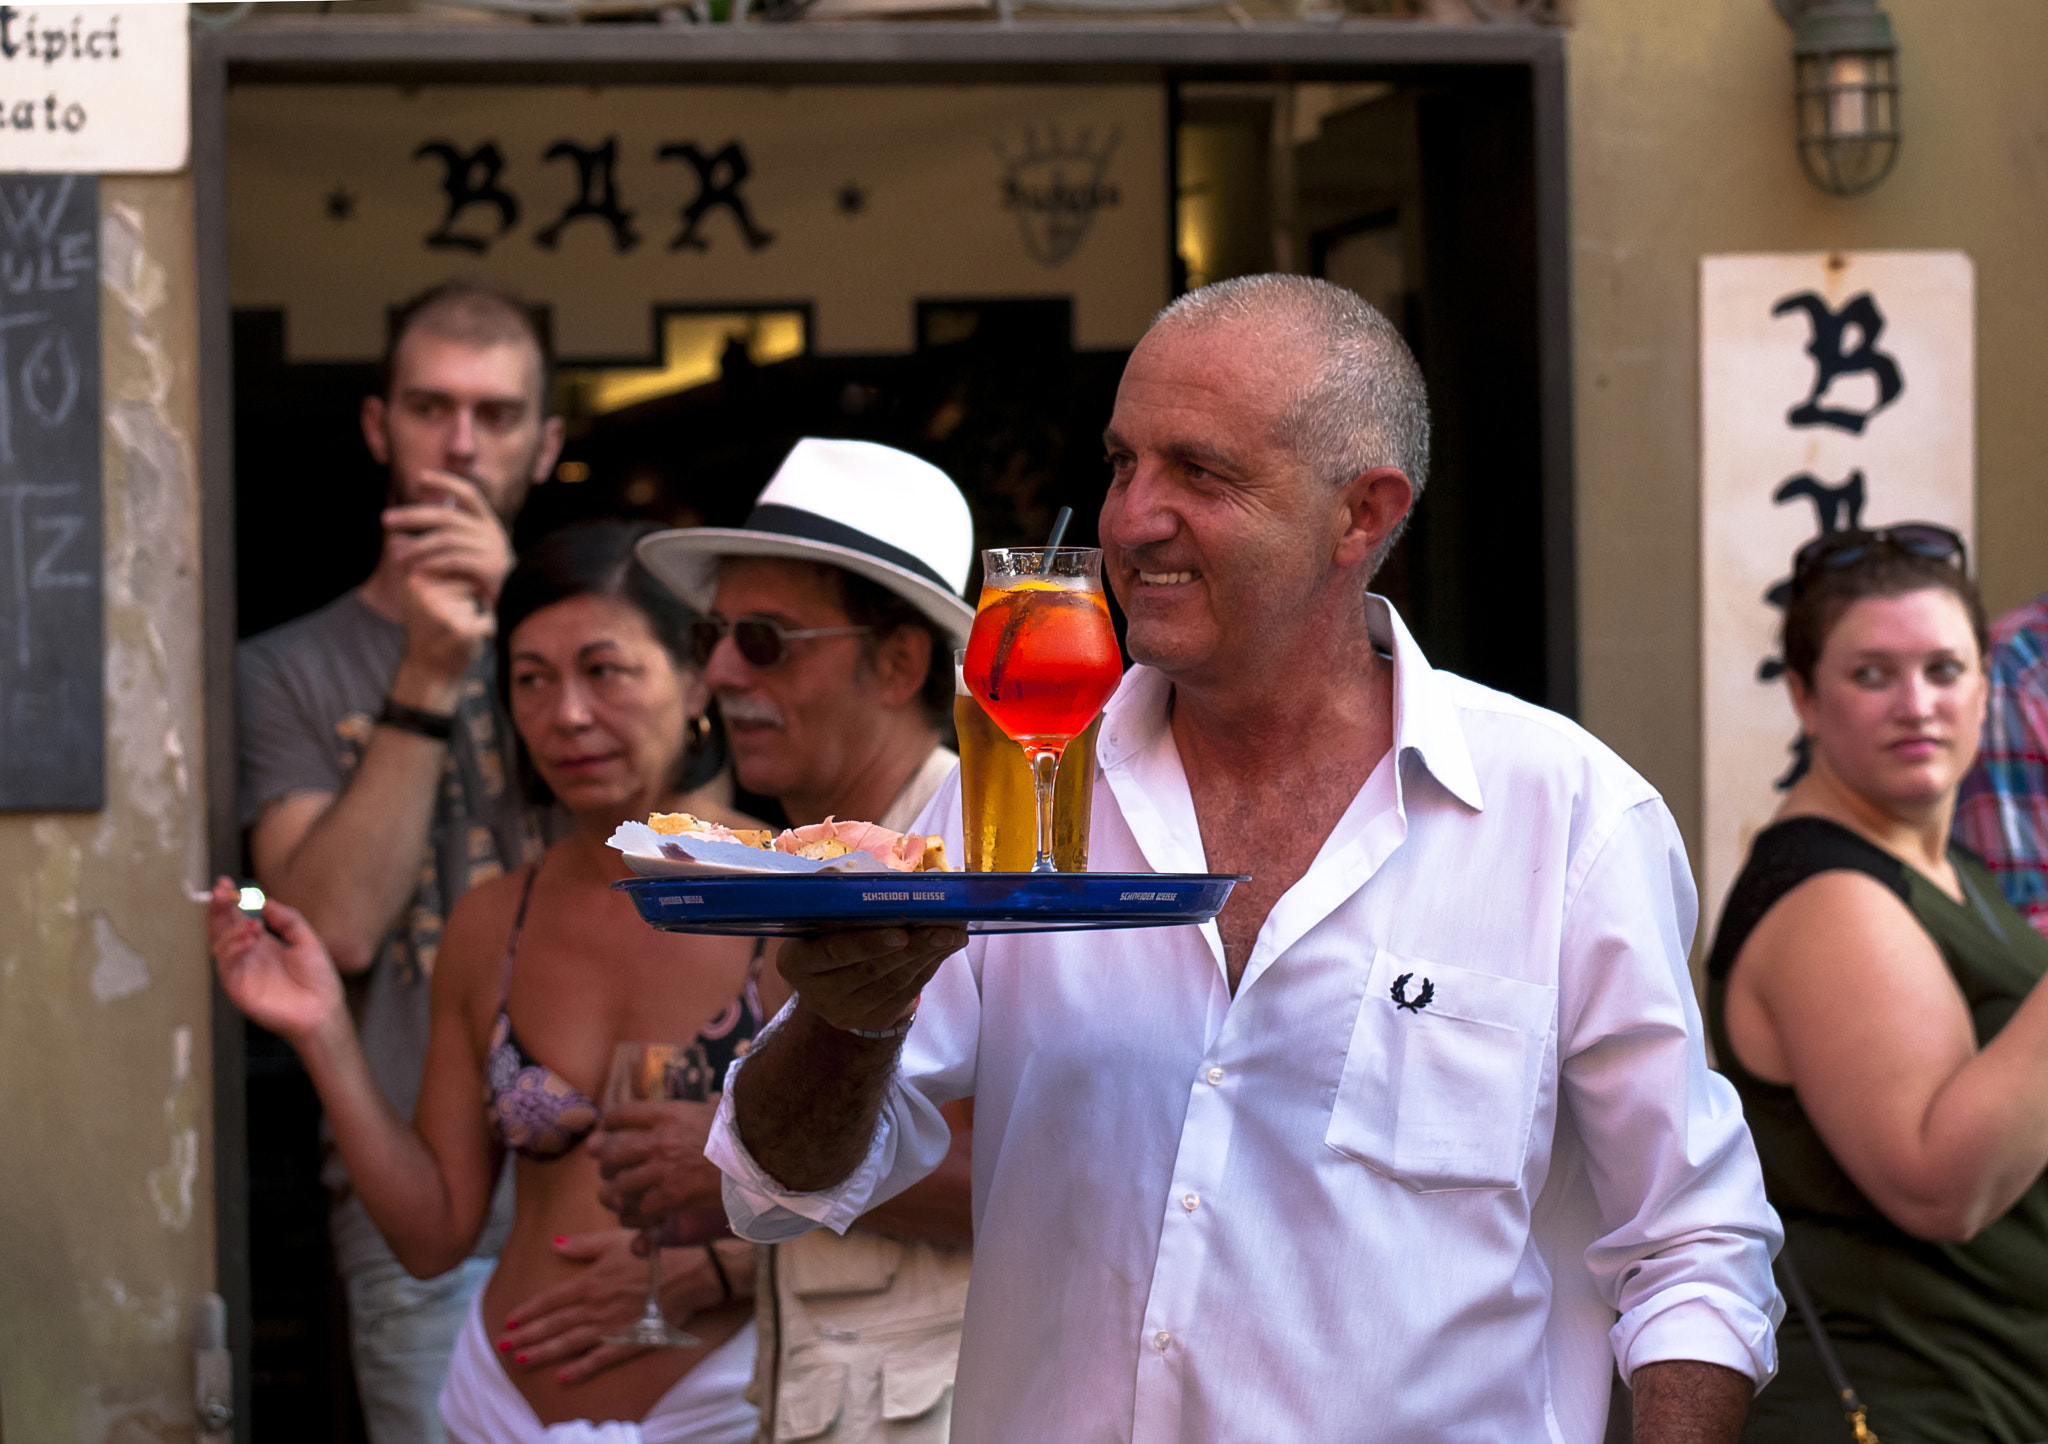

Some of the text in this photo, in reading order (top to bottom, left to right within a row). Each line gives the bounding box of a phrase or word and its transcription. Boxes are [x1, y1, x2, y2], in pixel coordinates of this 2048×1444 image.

[0, 93, 87, 133] ato
[412, 134, 778, 255] BAR
[862, 891, 946, 901] SCHNEIDER WEISSE
